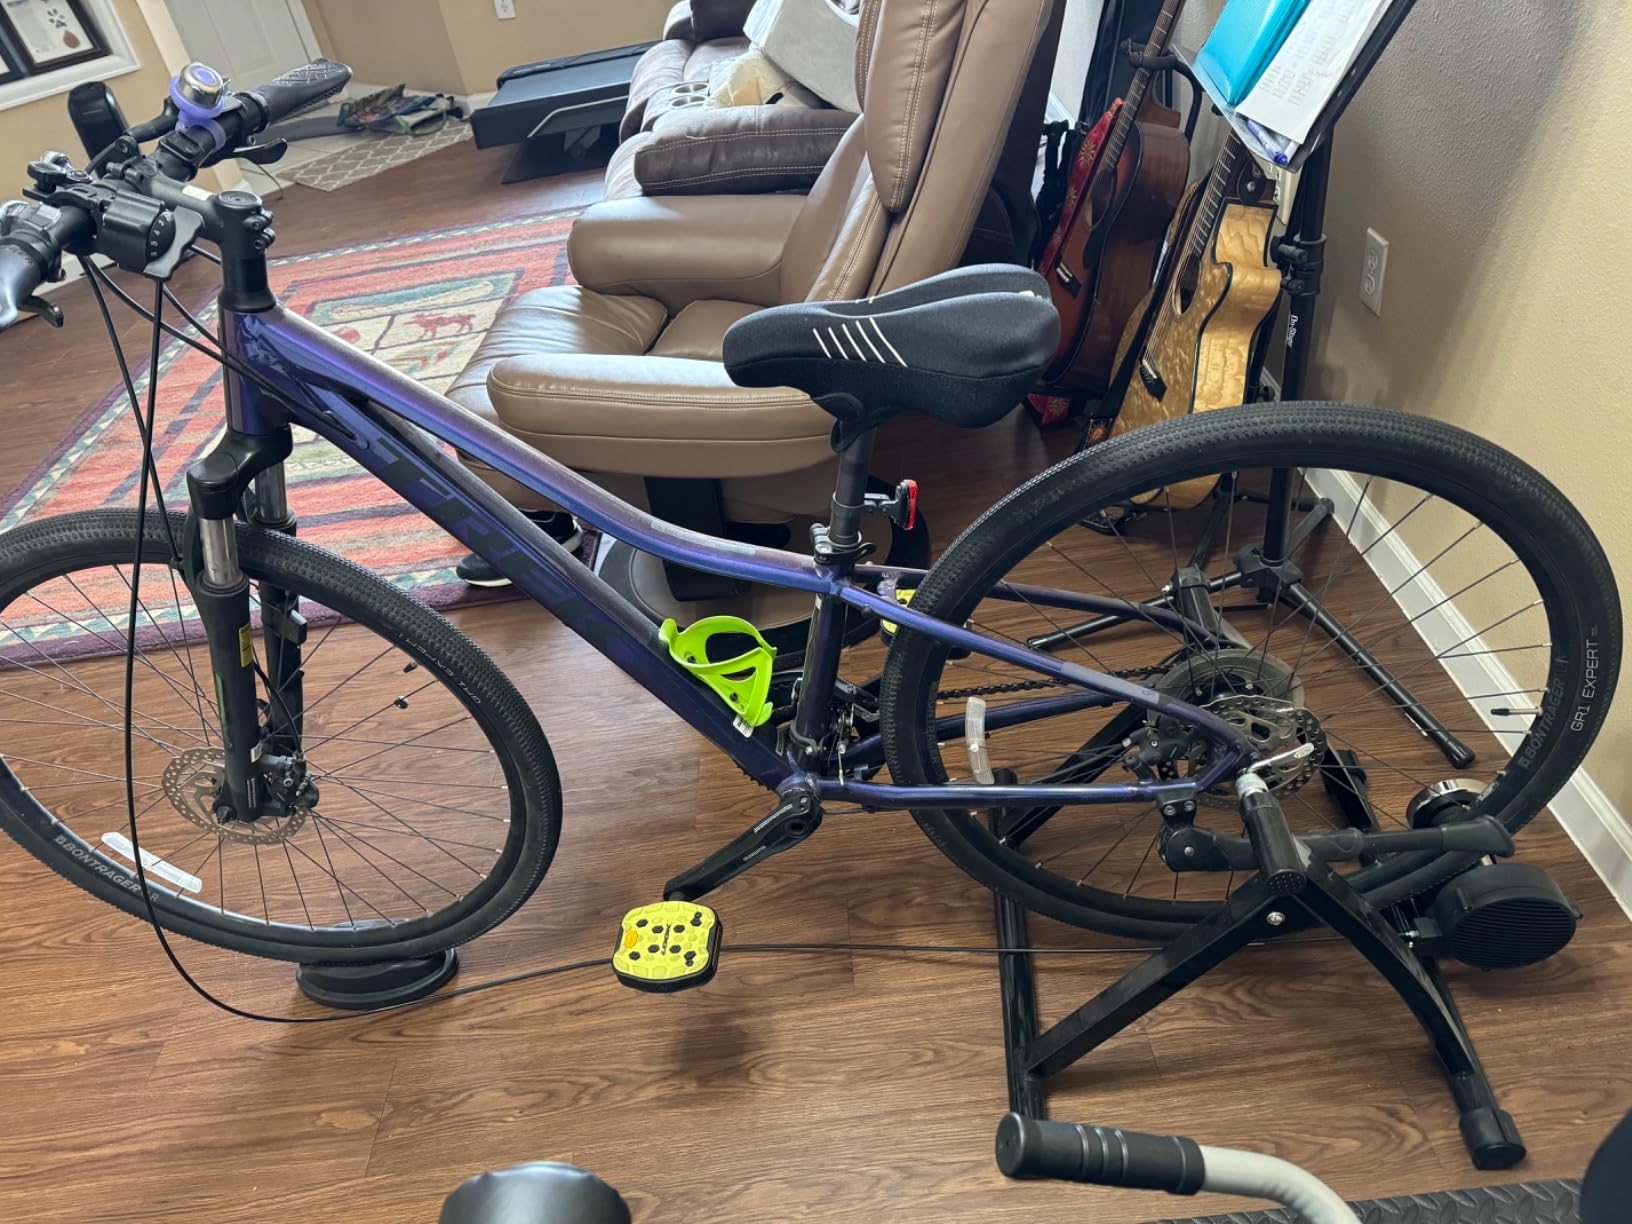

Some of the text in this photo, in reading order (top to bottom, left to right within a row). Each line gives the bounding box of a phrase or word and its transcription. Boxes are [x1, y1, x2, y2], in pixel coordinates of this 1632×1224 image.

[376, 437, 627, 650] TREK
[1524, 678, 1567, 759] BONTRAGER
[1570, 705, 1591, 732] GR1
[1582, 639, 1600, 699] EXPERT
[62, 841, 142, 896] BONTRAGER
[660, 919, 673, 956] LOOK
